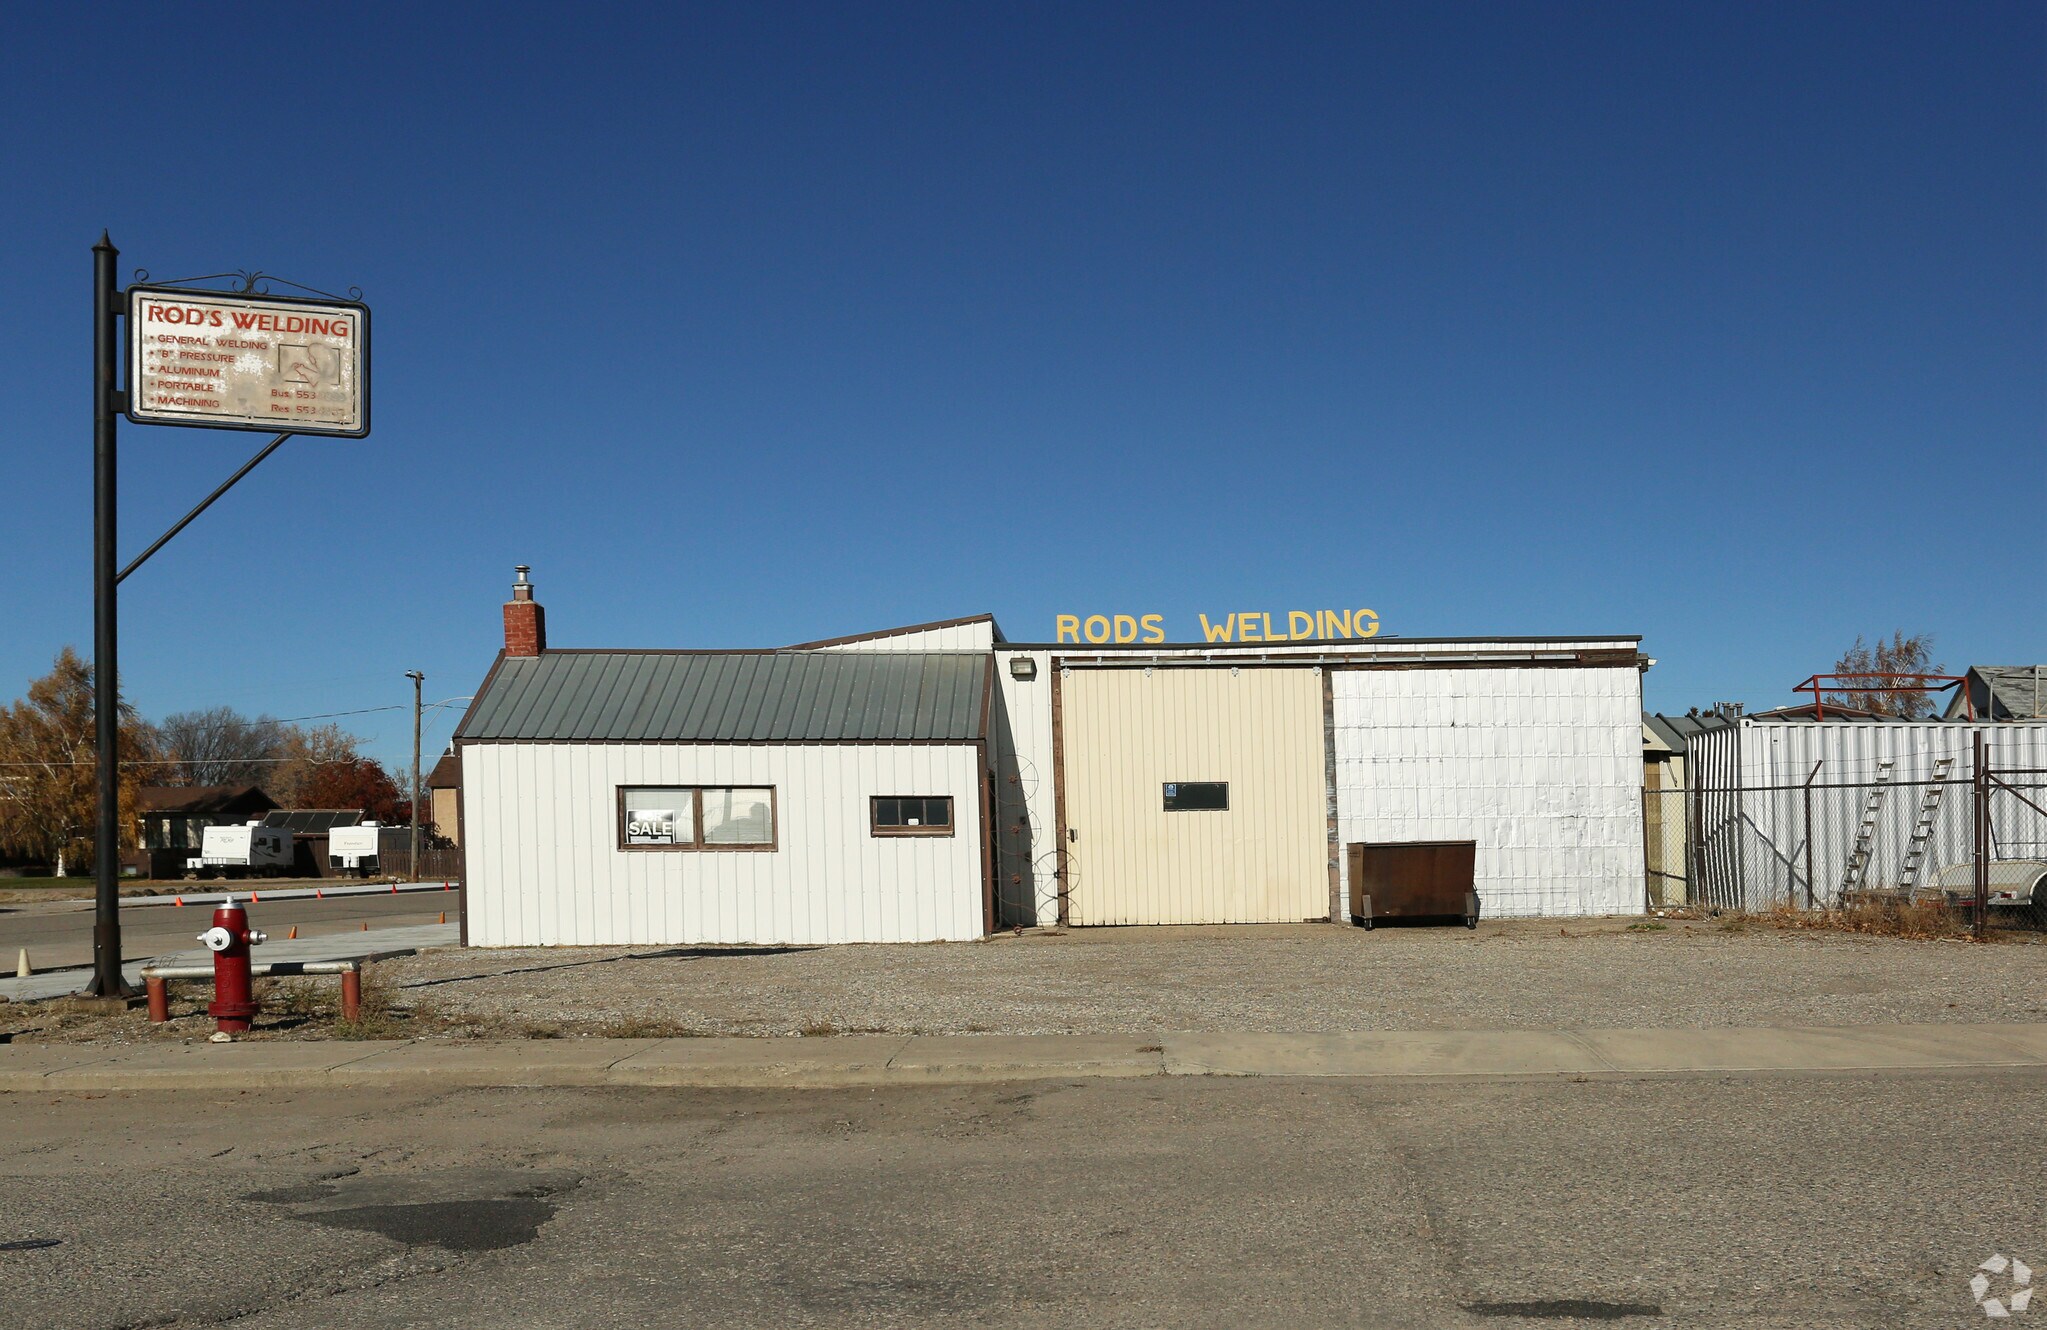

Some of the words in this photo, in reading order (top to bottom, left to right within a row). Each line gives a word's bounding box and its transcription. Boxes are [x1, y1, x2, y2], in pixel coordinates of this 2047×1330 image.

[148, 305, 222, 327] ROD'S
[231, 312, 348, 337] WELDING
[157, 335, 209, 347] GENERAL
[216, 339, 268, 351] WELDING
[179, 352, 236, 363] PRESSURE
[158, 366, 221, 378] ALUMINUM
[157, 381, 214, 393] PORTABLE
[157, 397, 221, 409] MACHINING
[1057, 614, 1165, 644] RODS
[1199, 609, 1380, 643] WELDING
[628, 821, 673, 836] SALE
